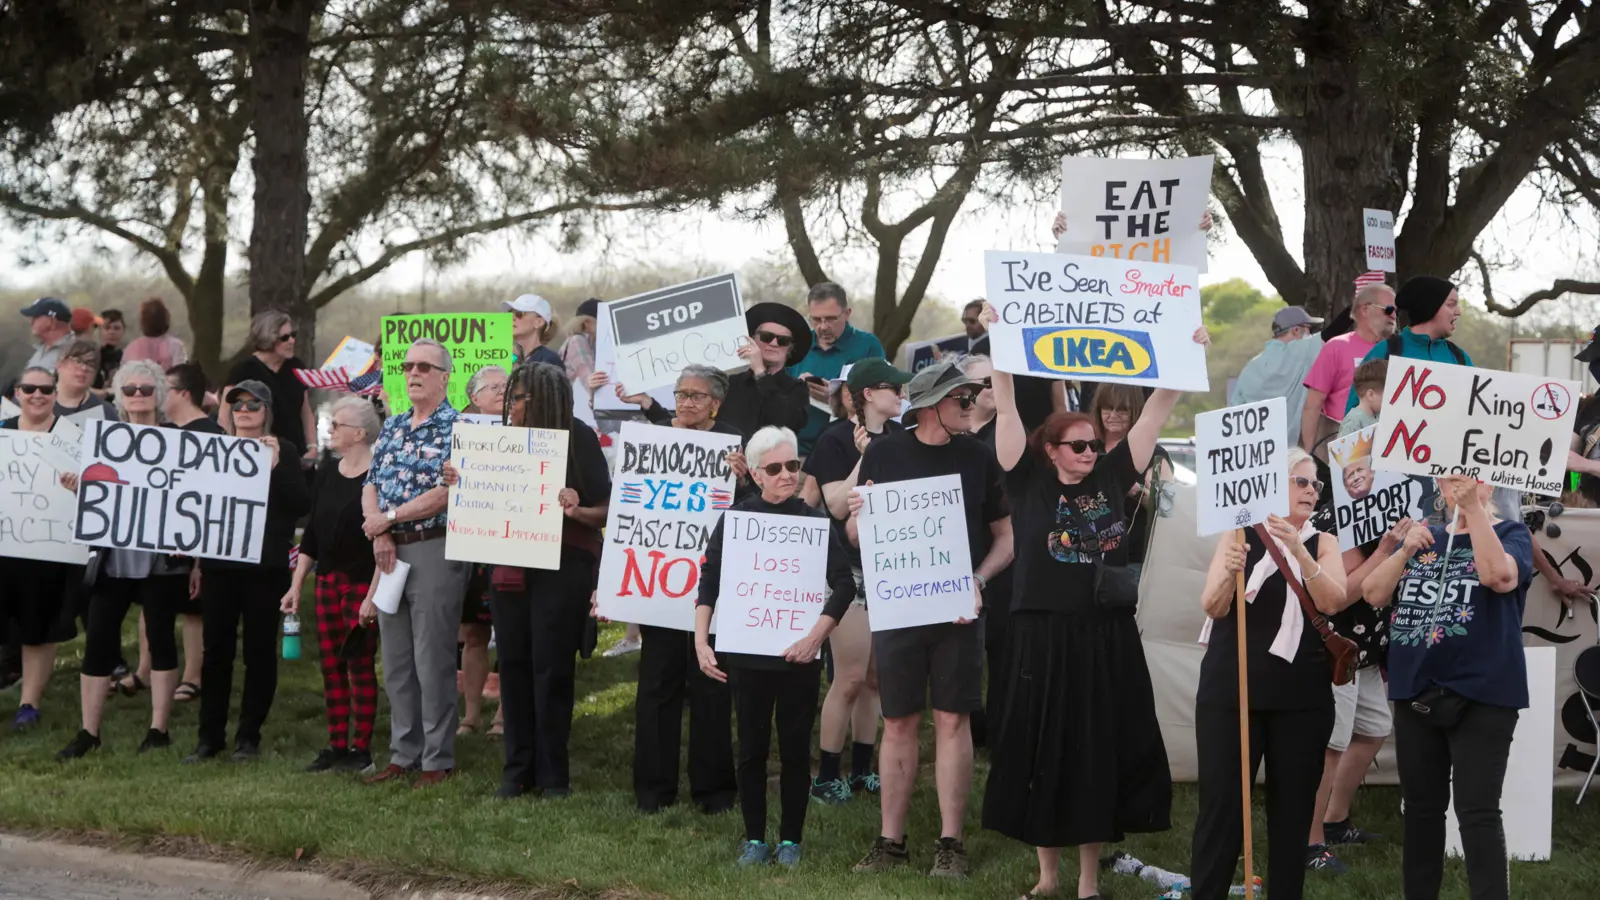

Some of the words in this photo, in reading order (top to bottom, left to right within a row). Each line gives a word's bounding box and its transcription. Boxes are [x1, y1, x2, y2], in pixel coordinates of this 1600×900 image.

[1105, 178, 1180, 211] EAT
[1095, 211, 1170, 240] THE
[1368, 245, 1394, 260] FASCISM
[1001, 259, 1053, 293] I've
[1058, 263, 1113, 297] Seen
[1119, 269, 1192, 298] Smarter
[645, 301, 704, 331] STOP
[1002, 301, 1126, 325] CABINETS
[1133, 301, 1164, 324] at
[385, 318, 495, 344] PRONOUN:
[392, 349, 409, 361] WO
[452, 348, 466, 359] IS
[475, 348, 509, 360] USED
[628, 347, 684, 382] The
[1053, 336, 1136, 371] IKEA
[387, 364, 405, 376] INS
[1468, 374, 1526, 430] King
[1221, 406, 1270, 438] STOP
[51, 434, 82, 460] DISSE
[94, 420, 167, 465] 100
[178, 431, 261, 478] DAYS
[453, 432, 497, 451] REPORT
[497, 435, 525, 454] CARD
[540, 460, 552, 476] F
[1207, 439, 1276, 476] TRUMP
[0, 460, 39, 491] AY
[146, 467, 186, 490] OF
[458, 476, 529, 494] HUMANITY
[540, 483, 552, 496] F
[1428, 463, 1448, 477] IN
[1491, 470, 1525, 486] White
[1525, 473, 1563, 493] House
[11, 491, 50, 511] TO
[643, 478, 708, 513] YES
[867, 492, 875, 515] I
[1336, 478, 1414, 530] DEPORT
[75, 480, 266, 559] BULLSHIT
[539, 503, 551, 516] F
[501, 520, 560, 543] IMPEACHED
[732, 516, 740, 540] I
[923, 516, 946, 538] Of
[1352, 502, 1412, 547] MUSK
[929, 546, 951, 567] IN
[616, 547, 706, 604] NO
[736, 582, 759, 597] Of
[745, 607, 806, 631] SAFE
[1395, 617, 1410, 626] Not
[1411, 618, 1425, 627] my
[1397, 607, 1412, 615] Not
[1413, 608, 1427, 617] my
